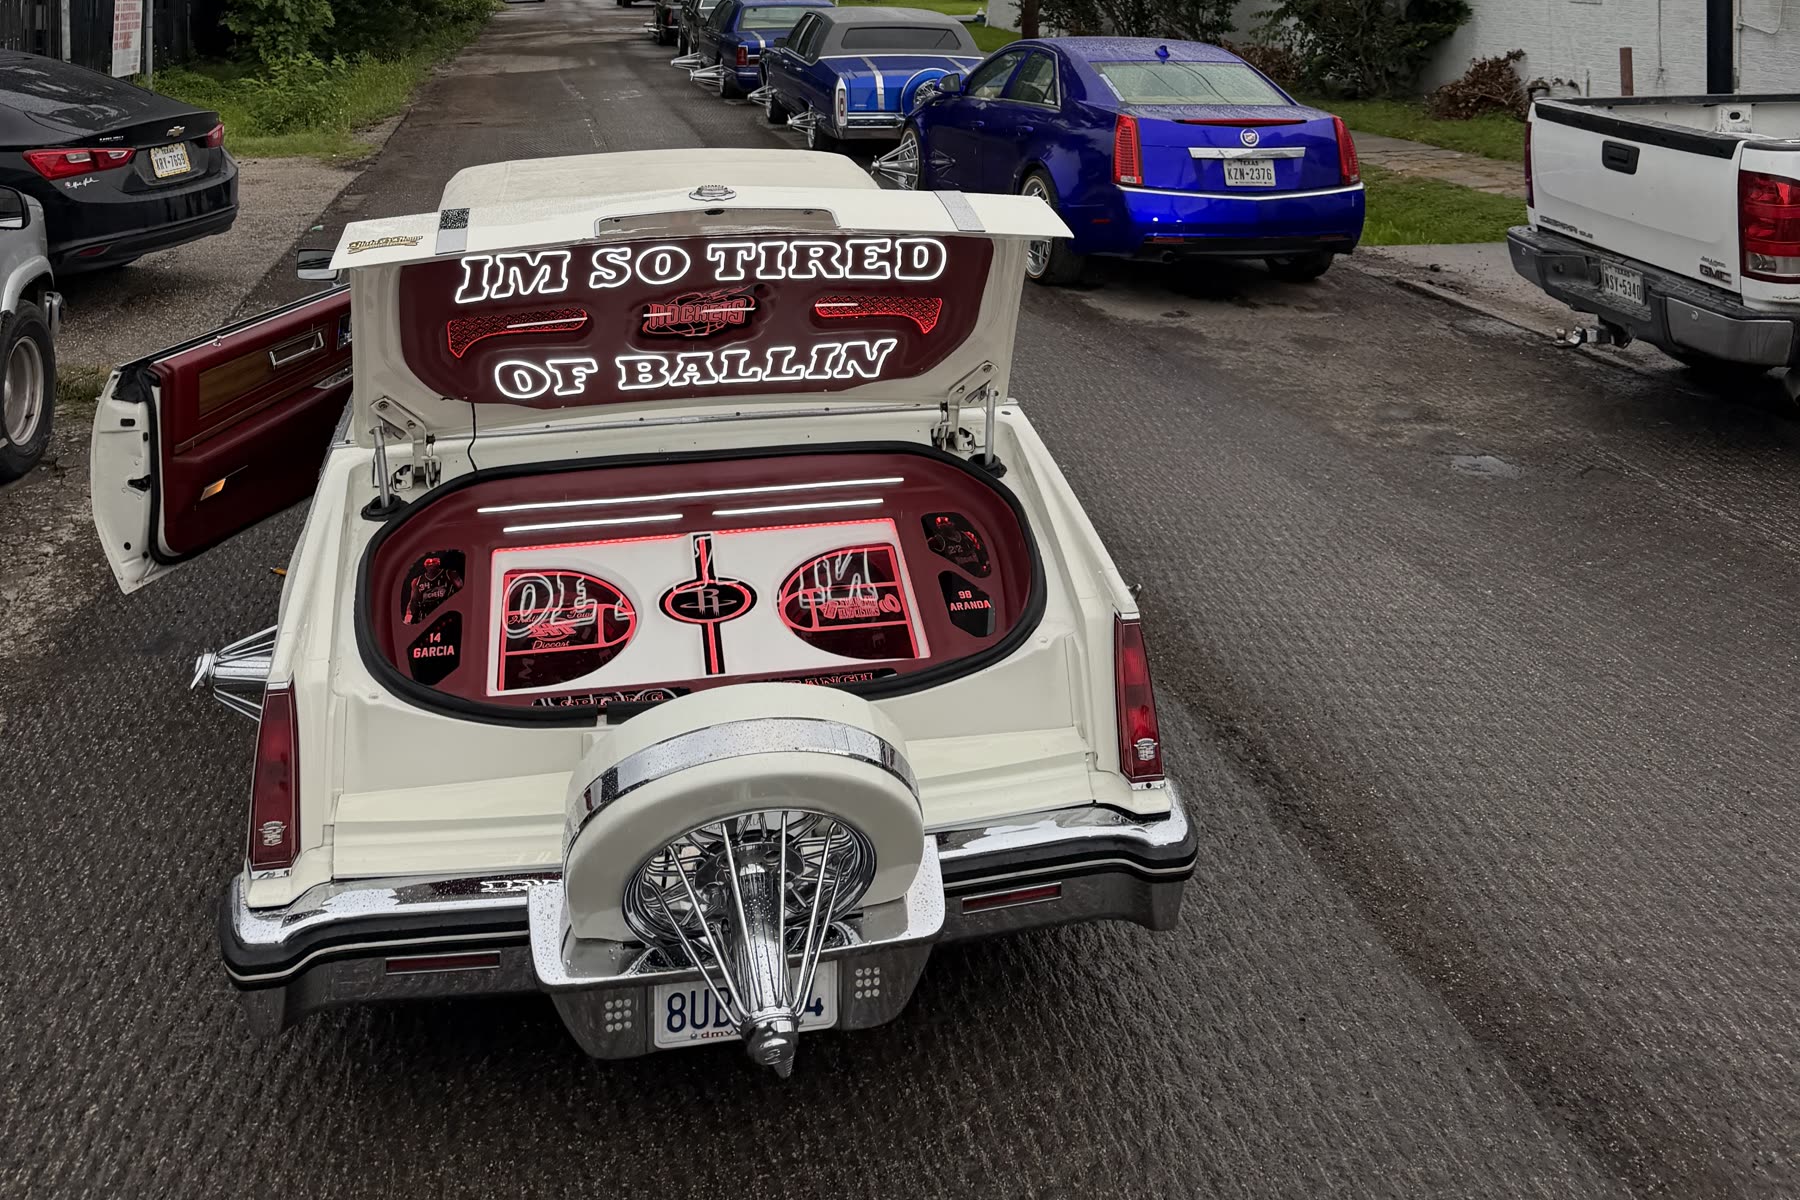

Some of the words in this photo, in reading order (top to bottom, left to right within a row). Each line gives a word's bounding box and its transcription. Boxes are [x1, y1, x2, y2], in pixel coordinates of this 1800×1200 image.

[455, 250, 571, 304] IM
[589, 246, 691, 289] SO
[706, 238, 947, 281] TIRED
[1700, 263, 1732, 285] GMC
[648, 298, 747, 329] ROCKETS
[495, 358, 598, 399] OF
[615, 338, 898, 390] BALLIN
[950, 600, 991, 611] ARANDA
[429, 633, 441, 643] 14
[413, 645, 454, 658] GARCIA
